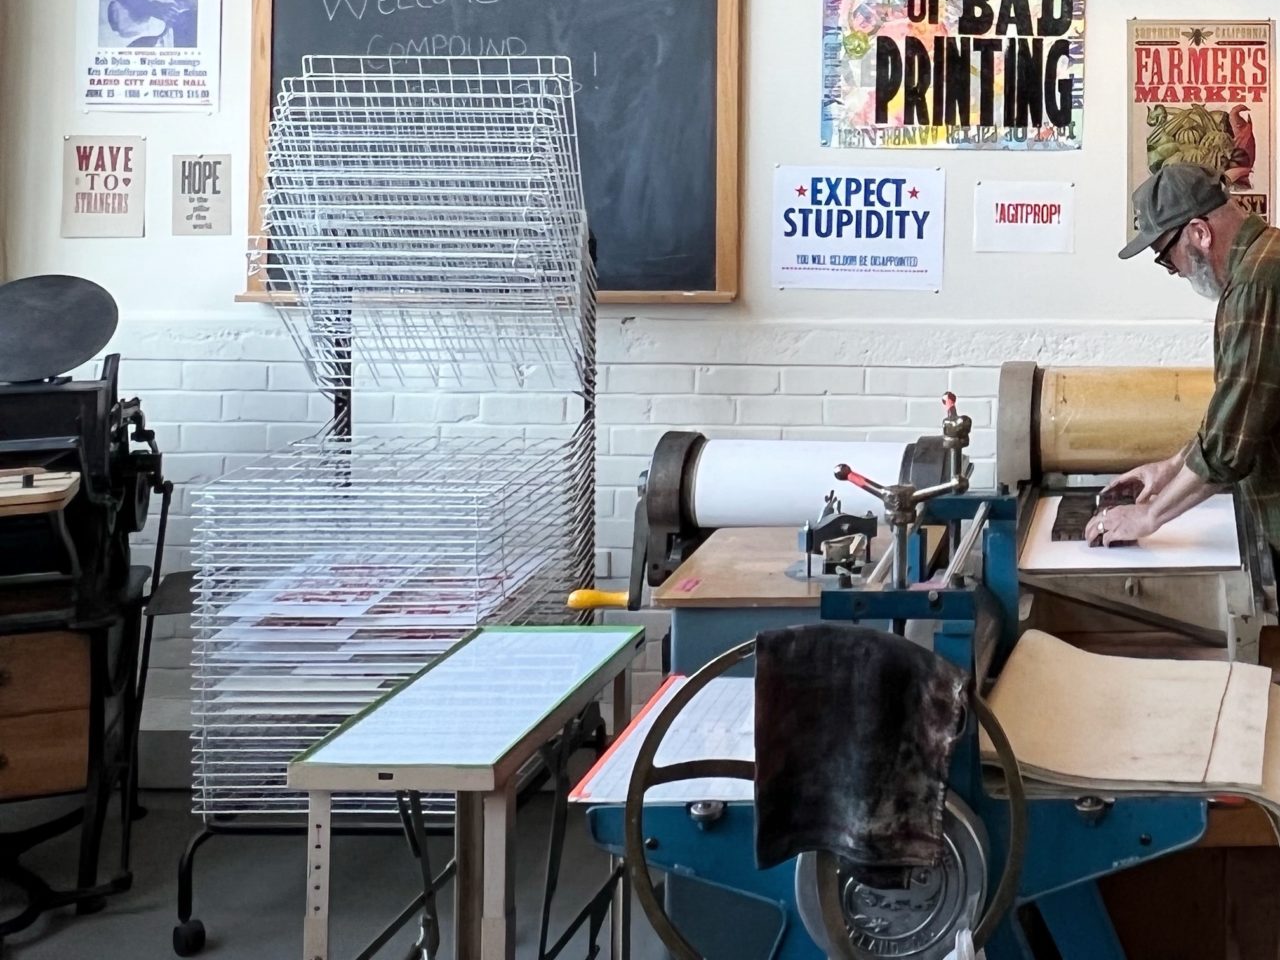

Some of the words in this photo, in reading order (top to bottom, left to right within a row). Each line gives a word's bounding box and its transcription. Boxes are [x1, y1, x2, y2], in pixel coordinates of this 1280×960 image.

[1135, 27, 1181, 39] SOUTHERN
[1215, 27, 1267, 39] CALIFORNIA
[95, 57, 108, 65] Bob
[1134, 47, 1267, 85] FARMER'S
[875, 37, 1072, 127] PRINTING
[153, 89, 183, 99] TICKETS
[1135, 87, 1267, 102] MARKET
[75, 145, 133, 172] WAVE
[85, 173, 118, 190] TO
[181, 161, 222, 194] HOPE
[74, 192, 129, 214] STRANGERS
[811, 177, 906, 207] EXPECT
[783, 208, 930, 239] STUPIDITY
[995, 202, 1061, 224] !AGITPROP!
[797, 255, 808, 264] YOU
[812, 255, 826, 264] WILL
[830, 255, 857, 265] SELDOM
[859, 256, 868, 266] BE
[871, 256, 918, 266] DISAPPOINTED
